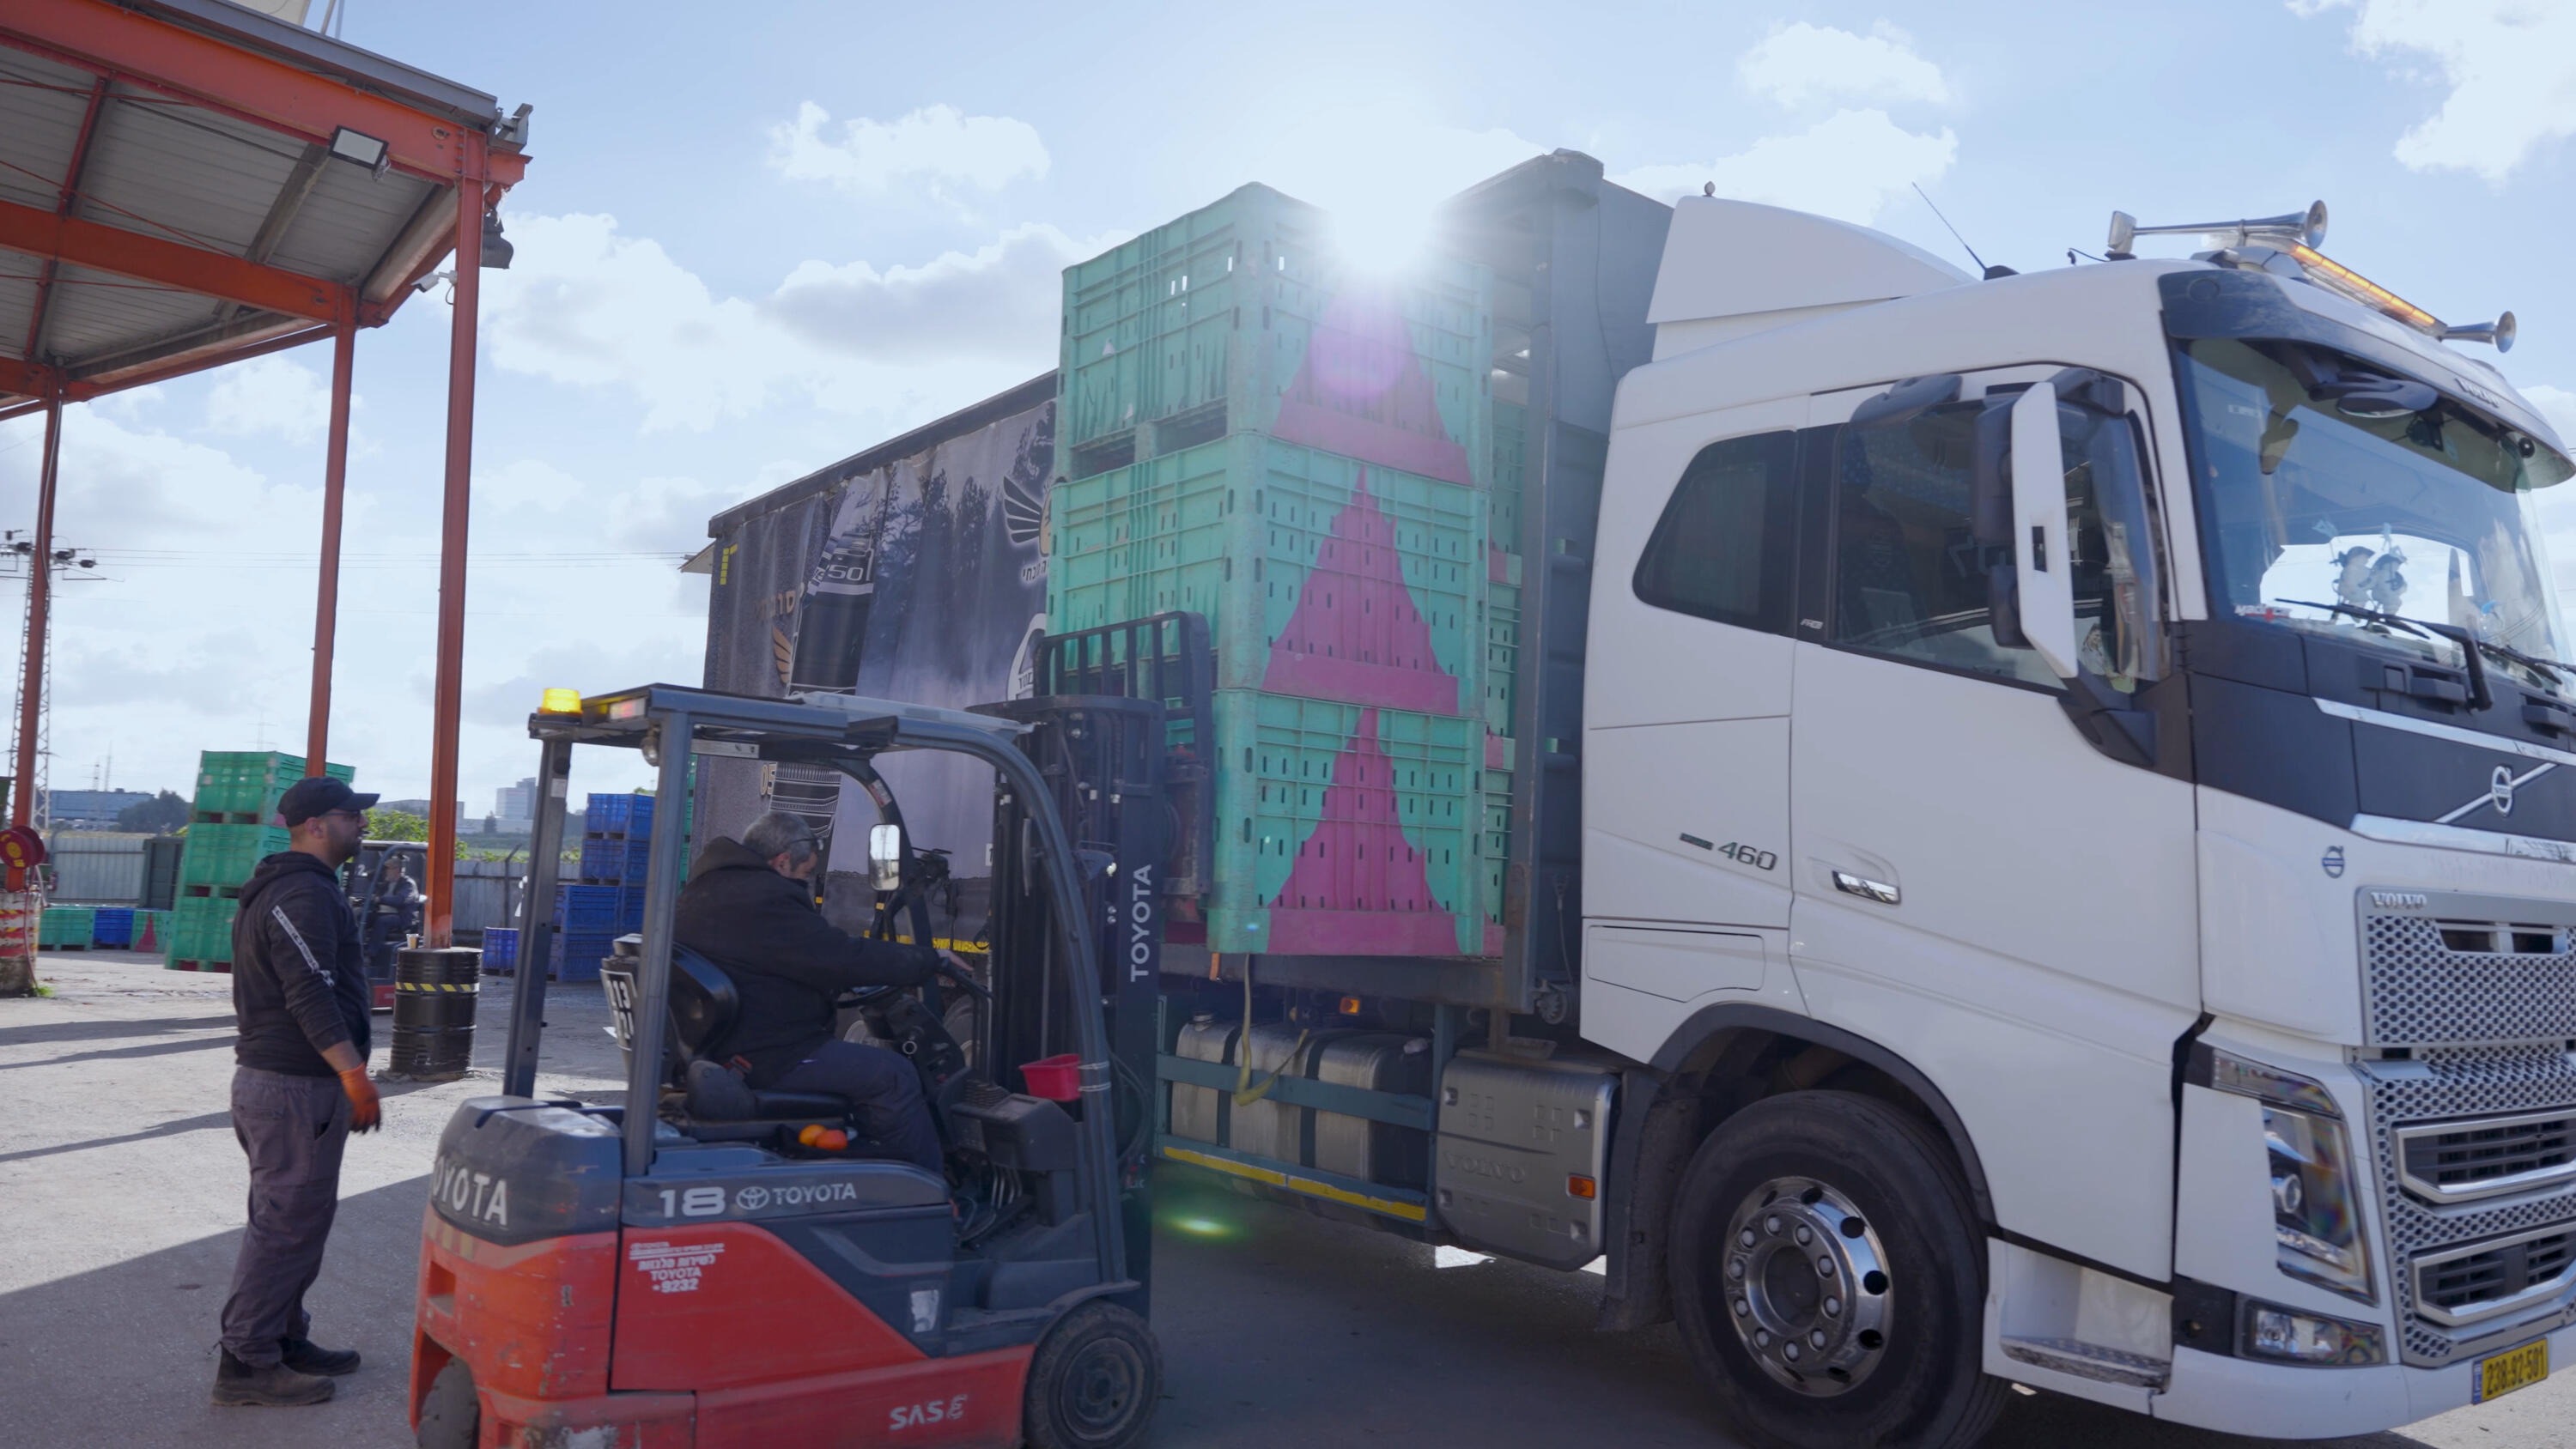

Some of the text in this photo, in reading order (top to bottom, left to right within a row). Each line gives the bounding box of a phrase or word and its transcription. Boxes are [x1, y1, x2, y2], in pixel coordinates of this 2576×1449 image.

[1717, 841, 1778, 871] 460
[2370, 892, 2428, 908] VOLVO
[1130, 864, 1152, 982] TOYOTA
[432, 1155, 507, 1227] OYOTA
[659, 1183, 856, 1218] 18 TOYOTA
[651, 1267, 702, 1281] TOYOTA
